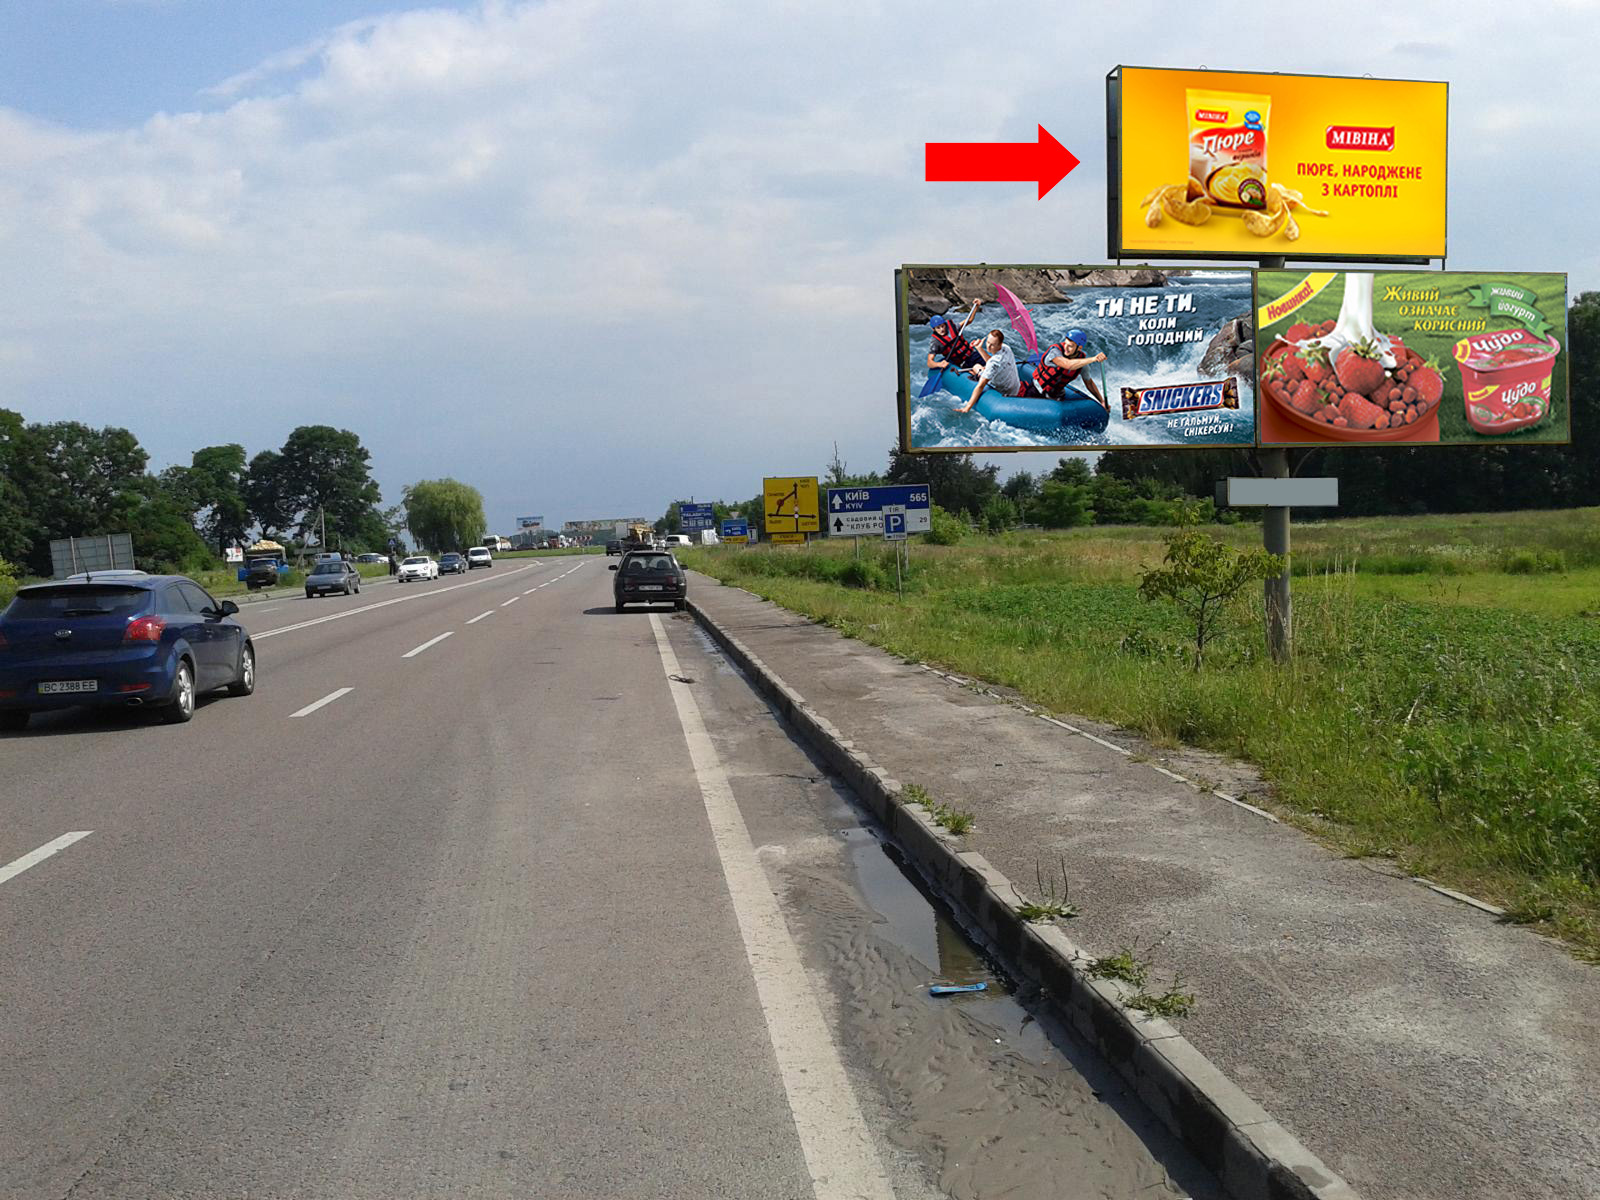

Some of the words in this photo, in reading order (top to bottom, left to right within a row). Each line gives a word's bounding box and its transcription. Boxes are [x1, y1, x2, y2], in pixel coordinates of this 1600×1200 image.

[1202, 131, 1255, 155] Пюре
[1331, 130, 1389, 146] МІВІНА
[1297, 163, 1338, 178] ПЮРЕ,
[1343, 164, 1422, 180] НАРОДЖЕНЕ
[1321, 183, 1330, 196] З
[1333, 183, 1398, 198] КАРТОПЛІ
[1266, 280, 1314, 320] Новинка!
[1490, 287, 1525, 301] живий
[1096, 298, 1125, 317] ТИ
[1130, 295, 1159, 315] НЕ
[1165, 293, 1197, 314] ТИ,
[1497, 300, 1536, 322] йогурт
[1139, 317, 1177, 331] КОЛИ
[1127, 328, 1204, 346] ГОЛОДНИЙ
[1472, 331, 1524, 353] Чудо
[1139, 383, 1224, 412] SNICKERS
[1501, 382, 1537, 409] Чудо
[1167, 418, 1179, 428] НЕ
[1184, 422, 1234, 437] СНІКЕРСУЙ!
[845, 489, 870, 501] КИЇВ
[909, 492, 927, 502] 565
[44, 682, 57, 692] BC
[59, 681, 81, 691] 2388
[82, 680, 96, 690] EE
